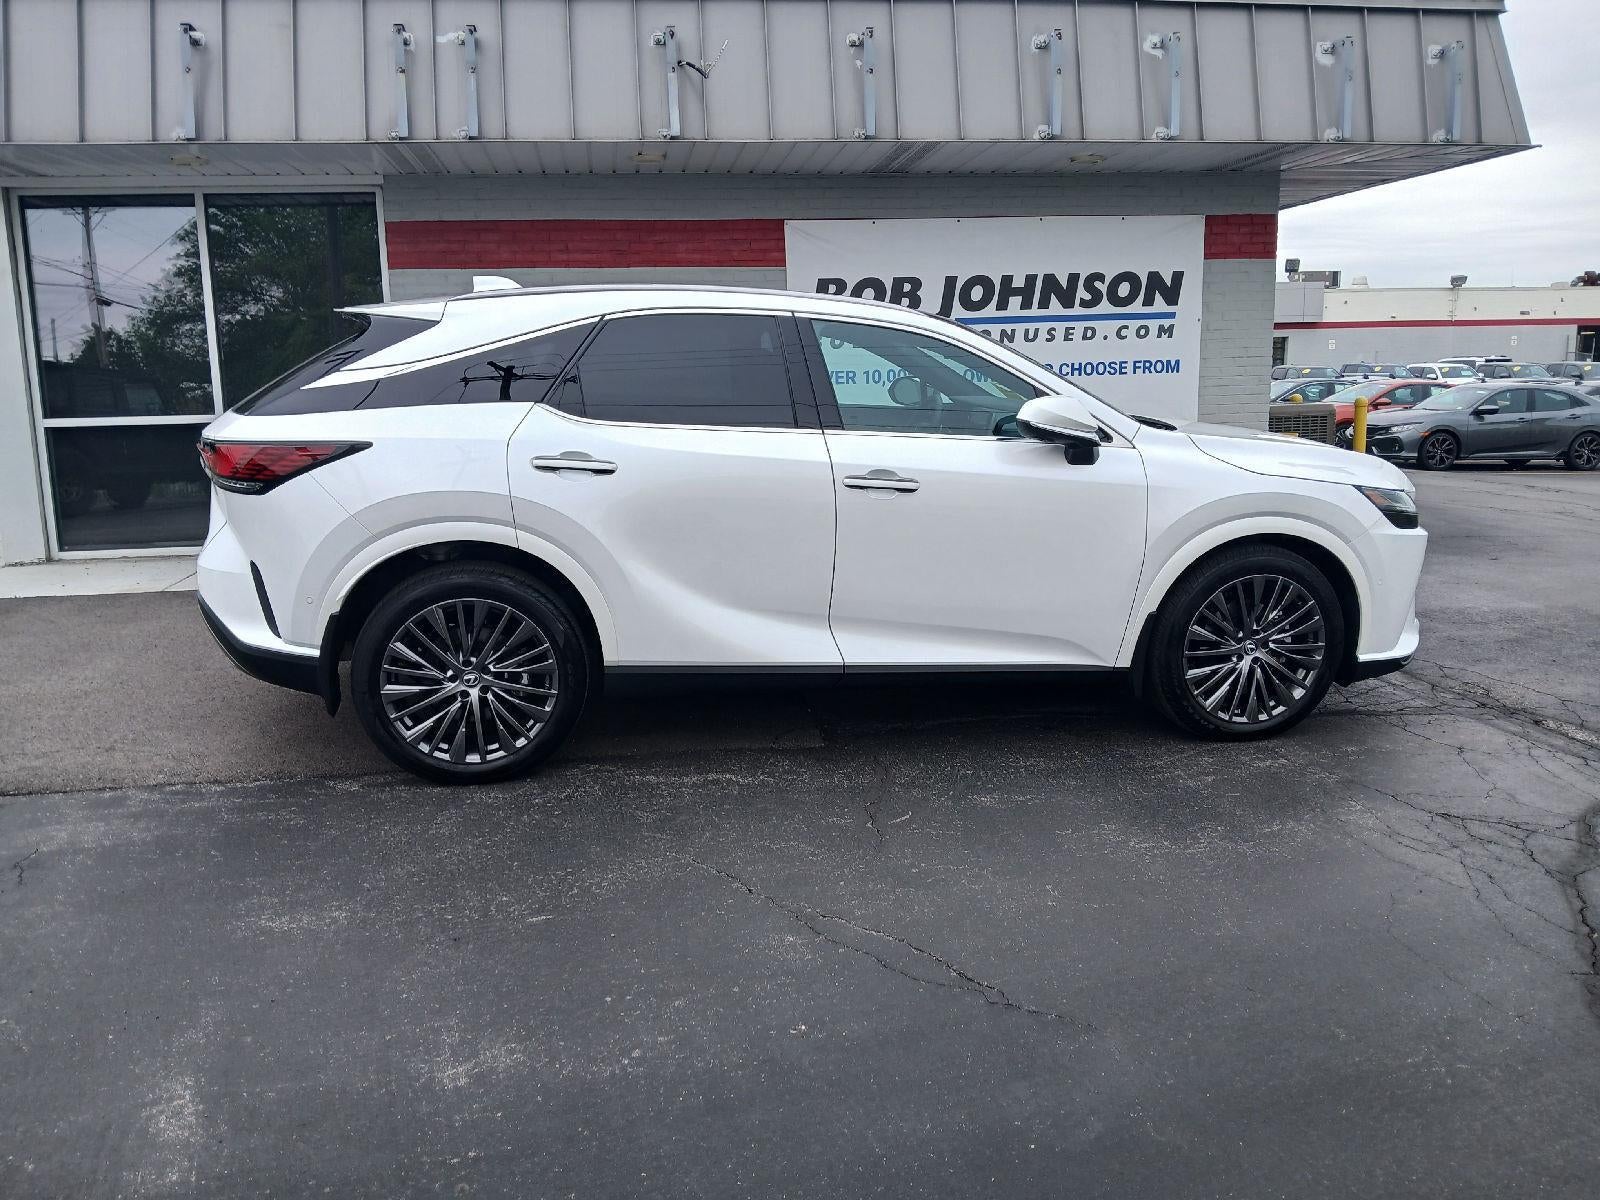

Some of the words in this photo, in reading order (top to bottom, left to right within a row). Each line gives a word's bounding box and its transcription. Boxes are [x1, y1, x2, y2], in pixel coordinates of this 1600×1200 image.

[936, 270, 1185, 319] JOHNSON
[1058, 360, 1128, 377] CHOOSE
[1132, 359, 1181, 375] FROM
